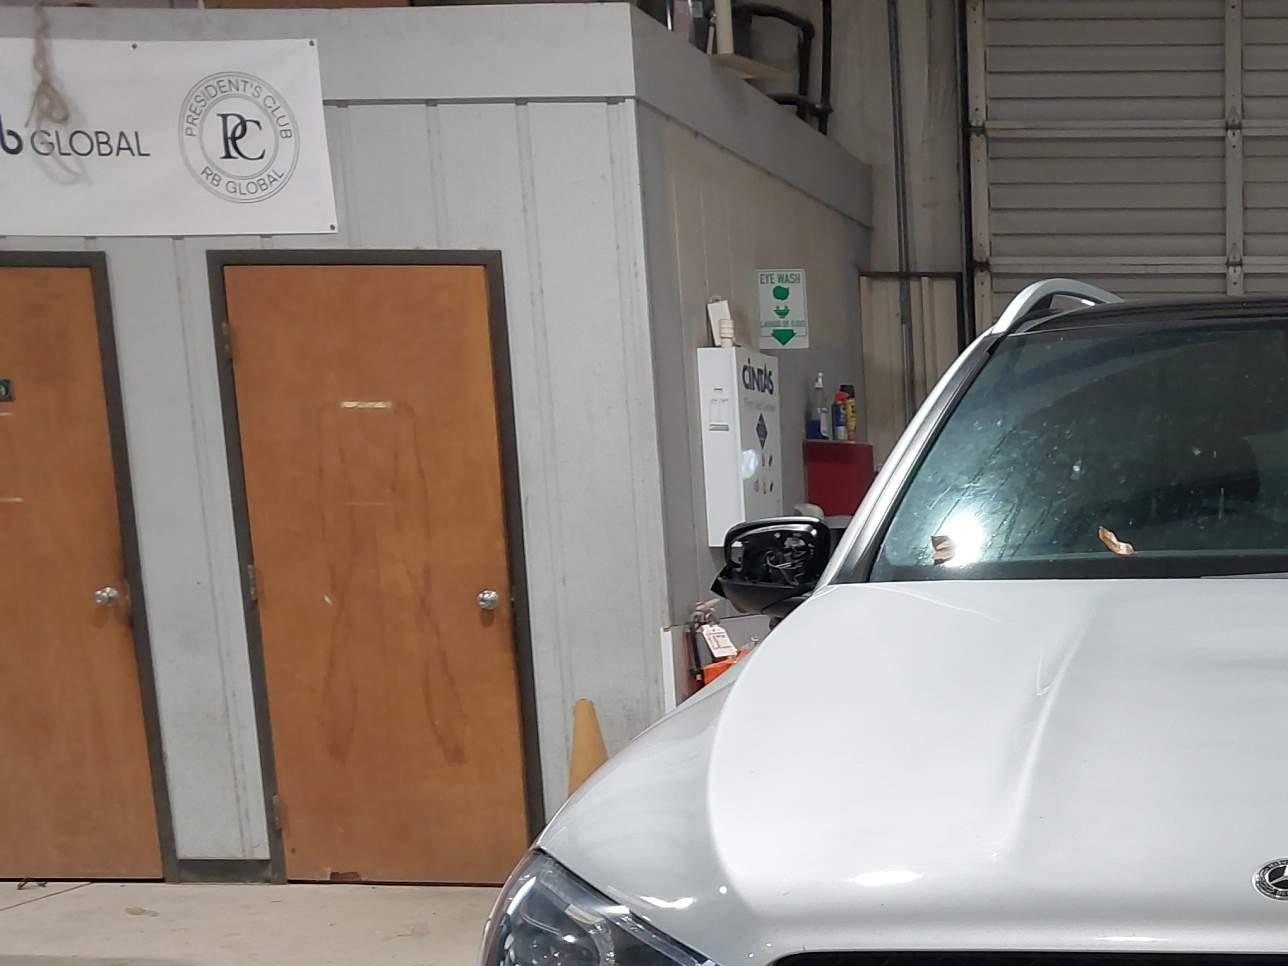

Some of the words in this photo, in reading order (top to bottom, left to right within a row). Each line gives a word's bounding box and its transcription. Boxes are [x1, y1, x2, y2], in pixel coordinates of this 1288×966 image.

[185, 79, 263, 137] PRESIDENT'S
[263, 95, 293, 140] CLUB
[30, 129, 151, 157] GLOBAL
[200, 165, 222, 188] RB
[225, 168, 285, 196] GLOBAL
[759, 273, 776, 285] EYE
[777, 272, 801, 284] WASH
